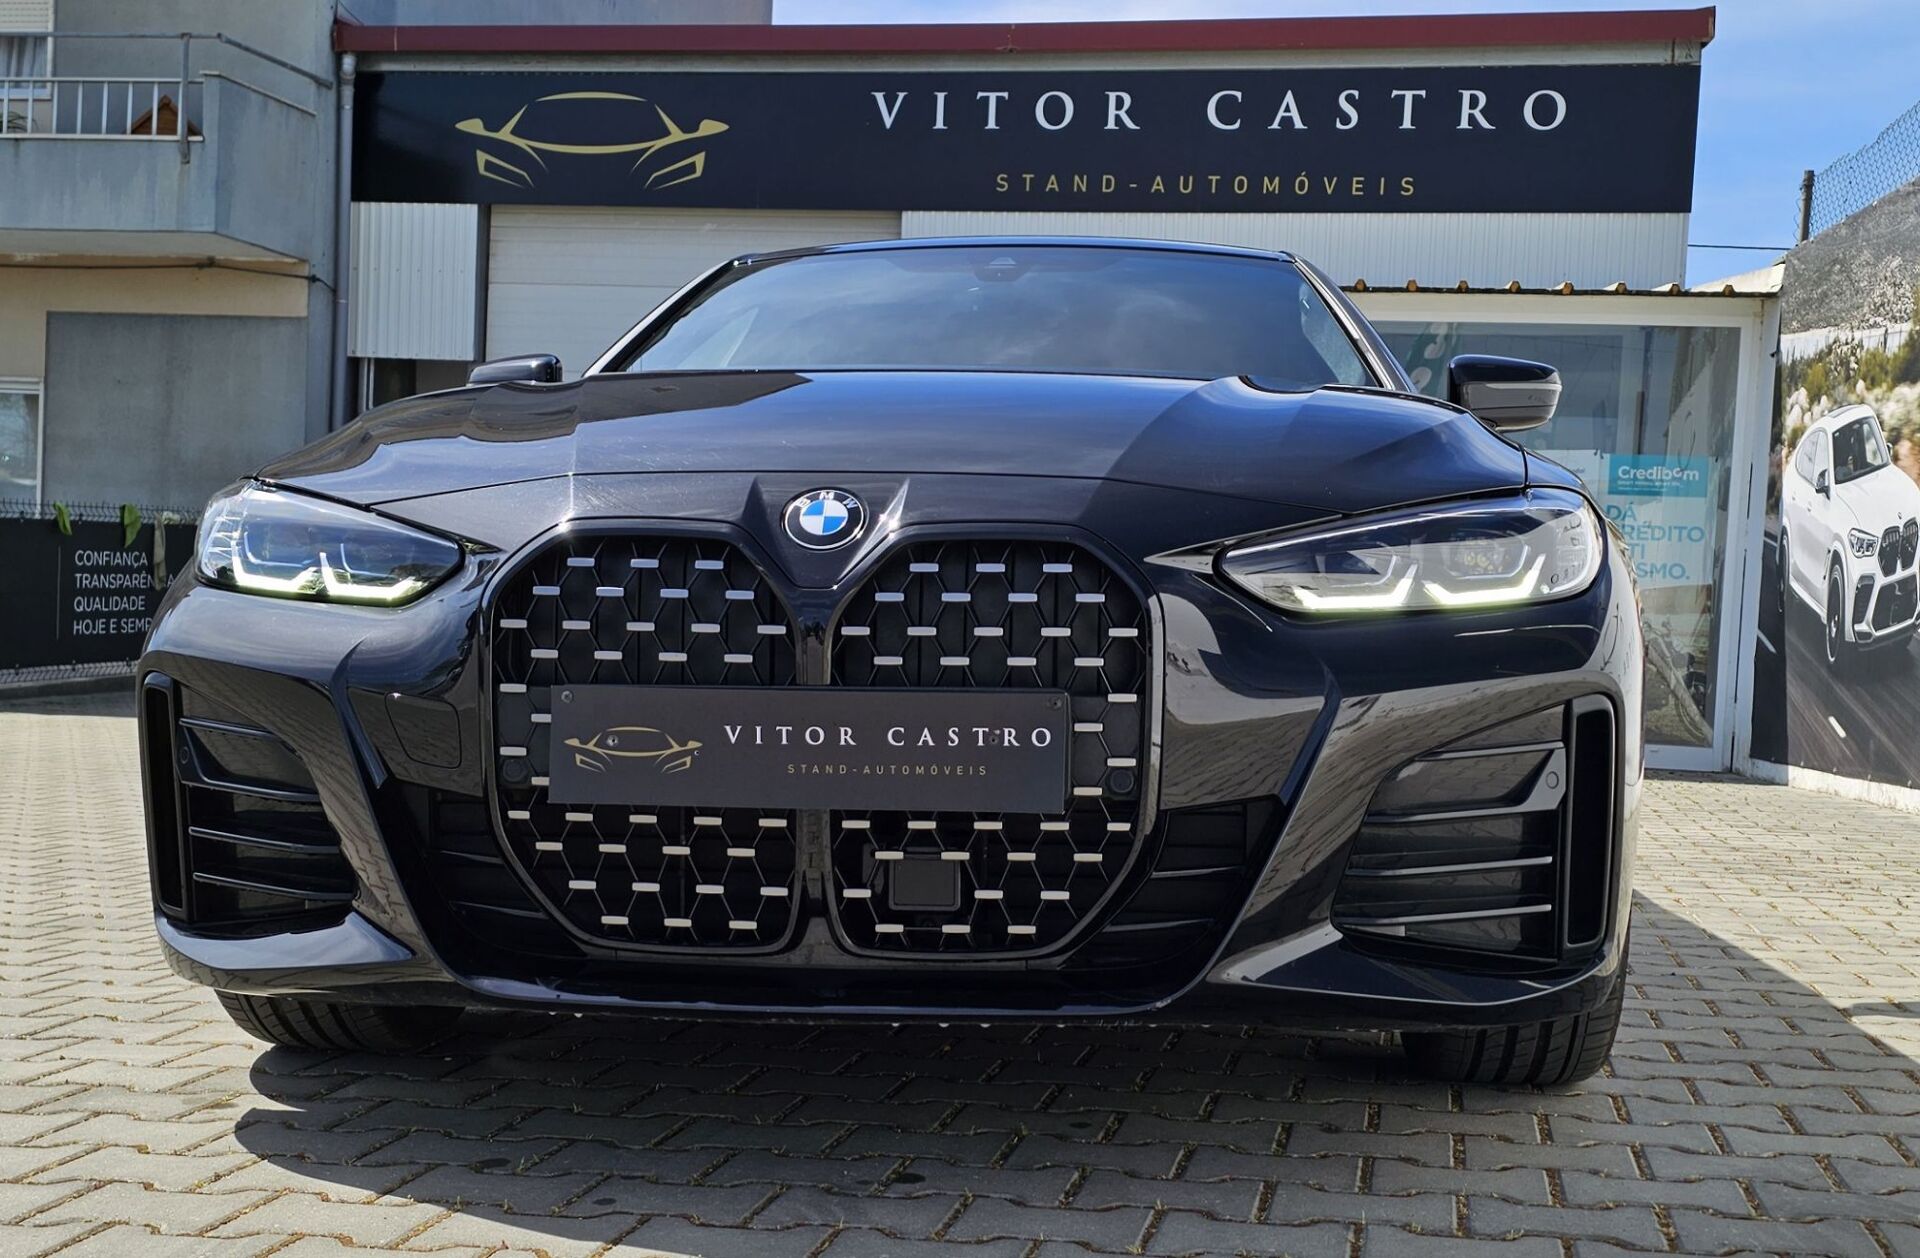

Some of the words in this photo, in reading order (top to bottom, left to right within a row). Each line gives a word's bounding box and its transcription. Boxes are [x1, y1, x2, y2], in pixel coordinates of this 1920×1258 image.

[870, 90, 1142, 131] VITOR
[1206, 89, 1568, 131] CASTRO
[995, 171, 1416, 196] STAND-AUTOMÓVEIS
[1617, 465, 1700, 482] Credibom
[1606, 501, 1637, 523] DÁ
[1618, 521, 1706, 544] RÉDITO
[74, 549, 149, 570] CONFIANÇA
[74, 570, 174, 590] TRANSPARÊNA
[1636, 561, 1691, 581] SMO.
[73, 595, 146, 613] QUALIDADE
[73, 619, 107, 636] HOJE
[109, 618, 118, 634] E
[120, 617, 152, 635] SEMP
[723, 724, 857, 746] VITOR
[887, 726, 1052, 747] CASTRO
[787, 763, 988, 776] STAND-AUTOMÓVEIS
